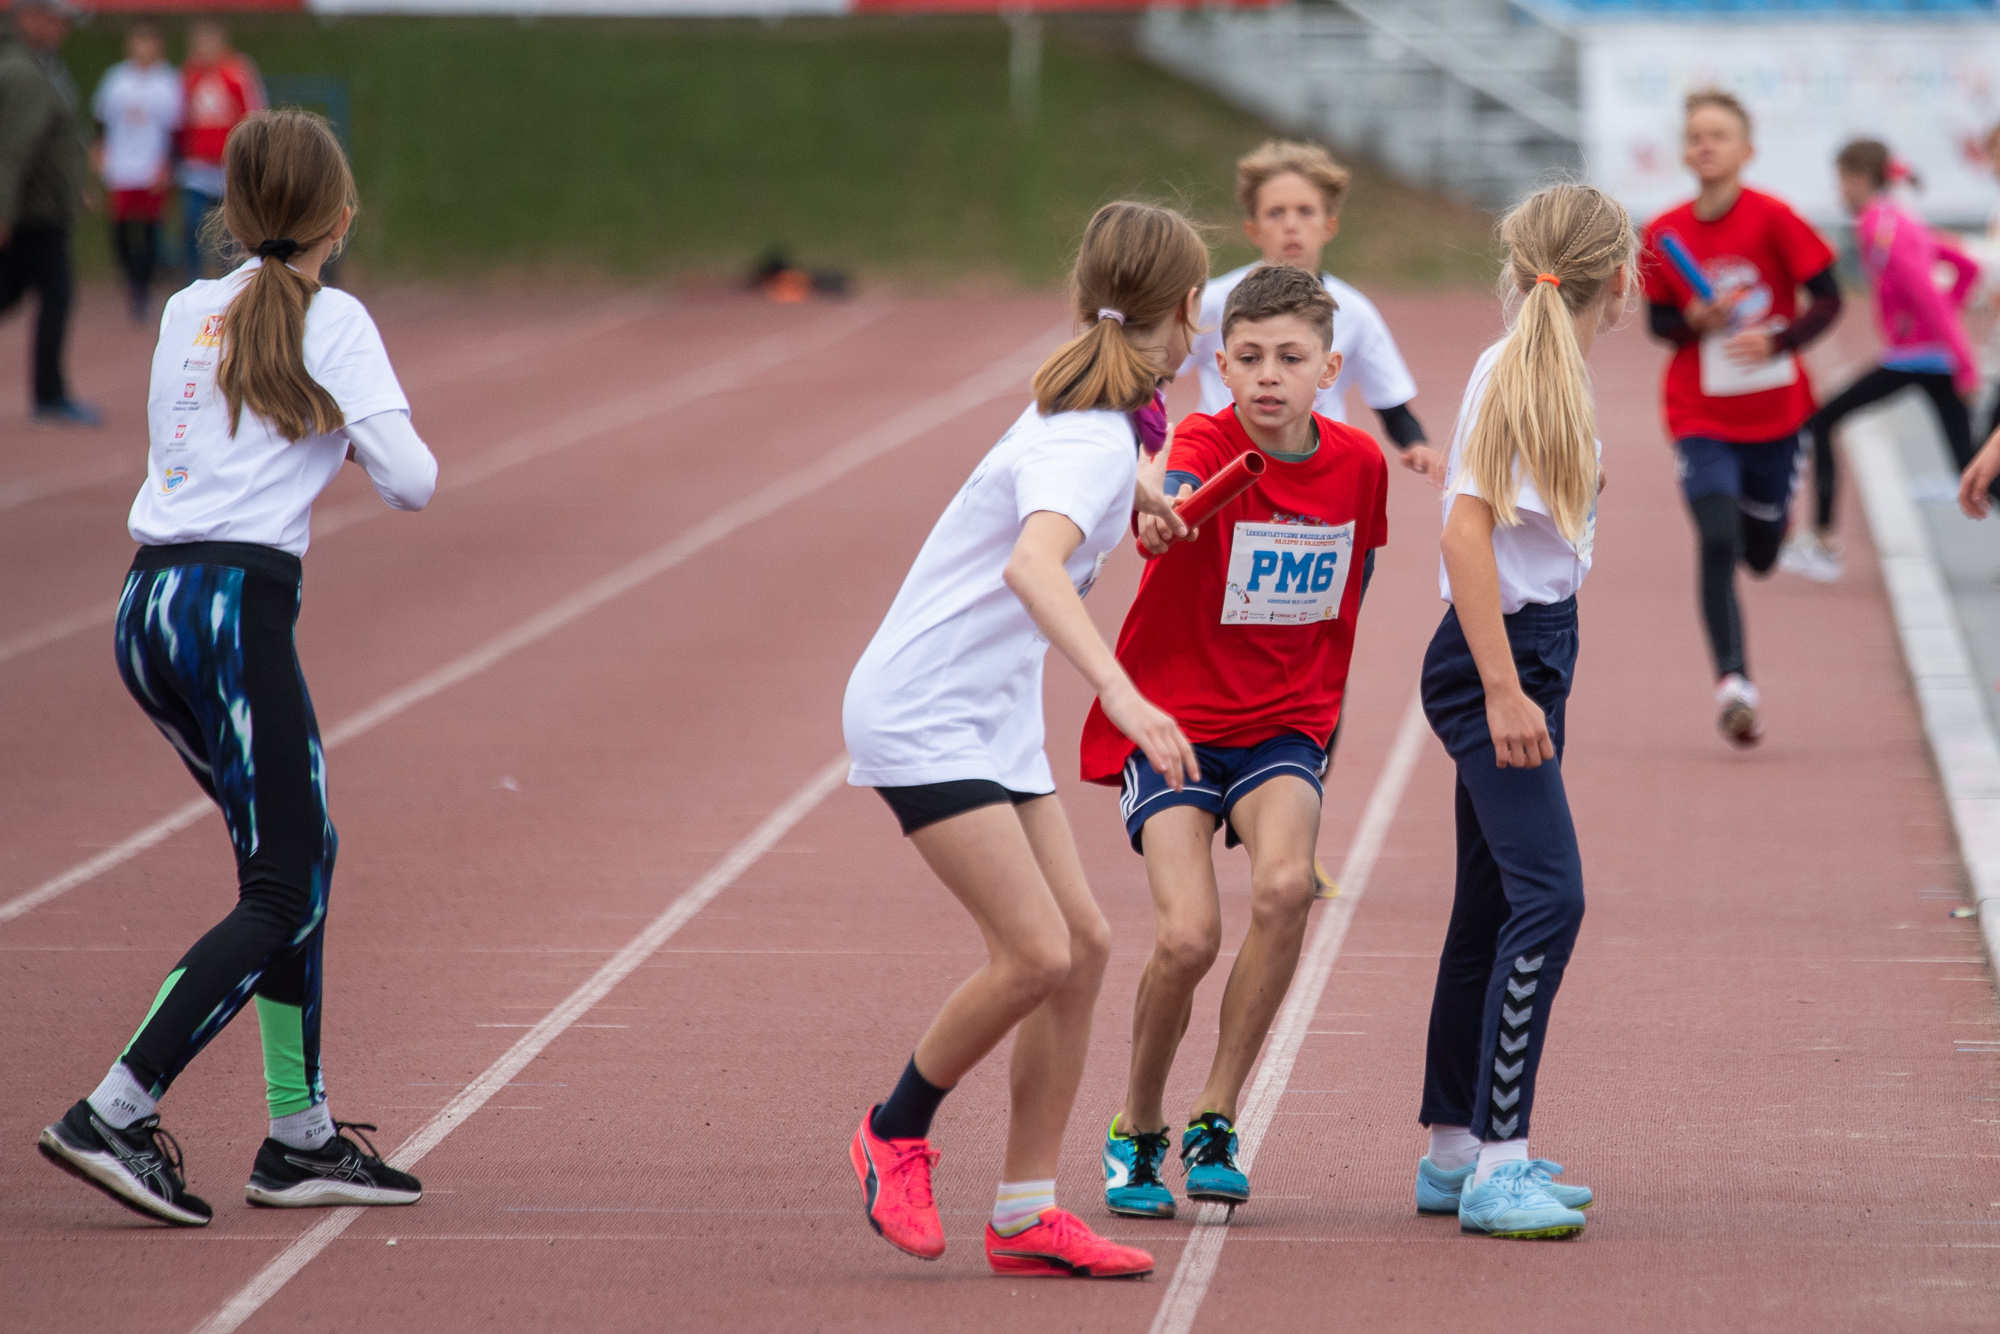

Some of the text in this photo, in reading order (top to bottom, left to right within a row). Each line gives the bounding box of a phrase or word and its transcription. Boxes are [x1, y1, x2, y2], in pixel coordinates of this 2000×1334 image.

[1246, 550, 1337, 593] PM6
[112, 1098, 137, 1114] SUN
[305, 1124, 327, 1139] SUN
